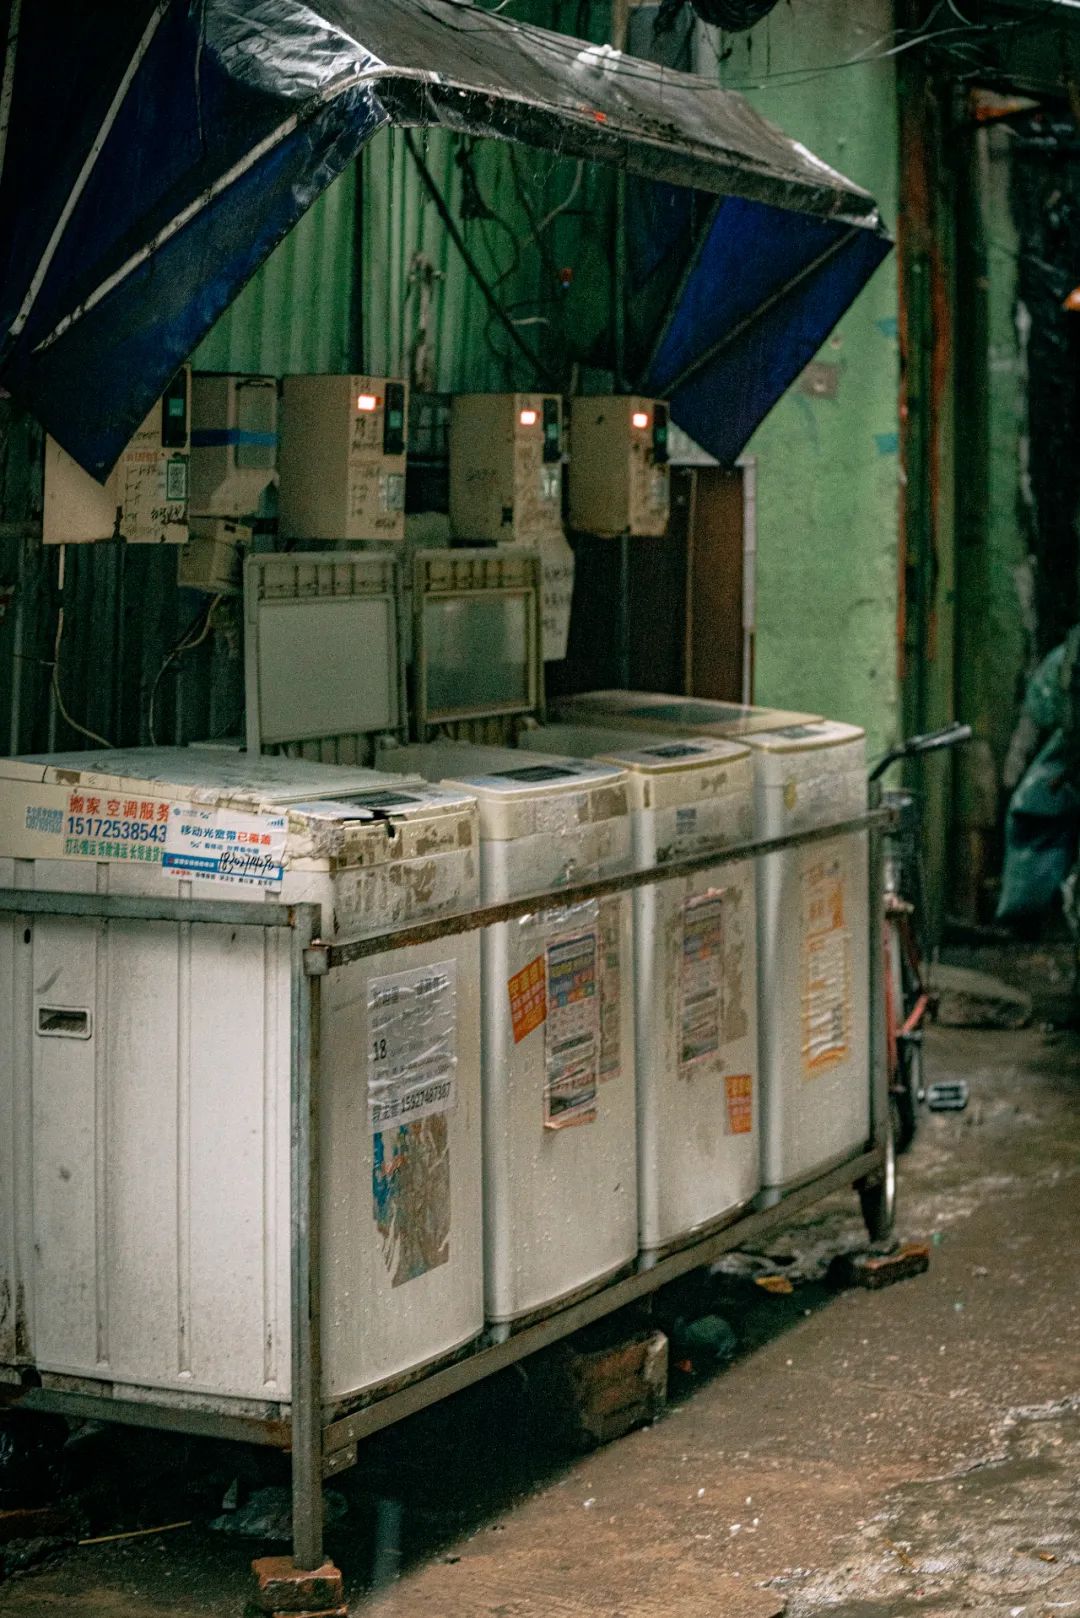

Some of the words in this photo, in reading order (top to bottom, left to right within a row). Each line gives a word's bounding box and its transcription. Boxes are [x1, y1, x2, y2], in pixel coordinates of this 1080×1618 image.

[69, 795, 101, 815] 搬家
[107, 799, 170, 823] 空调服务
[67, 816, 168, 843] 15172538543
